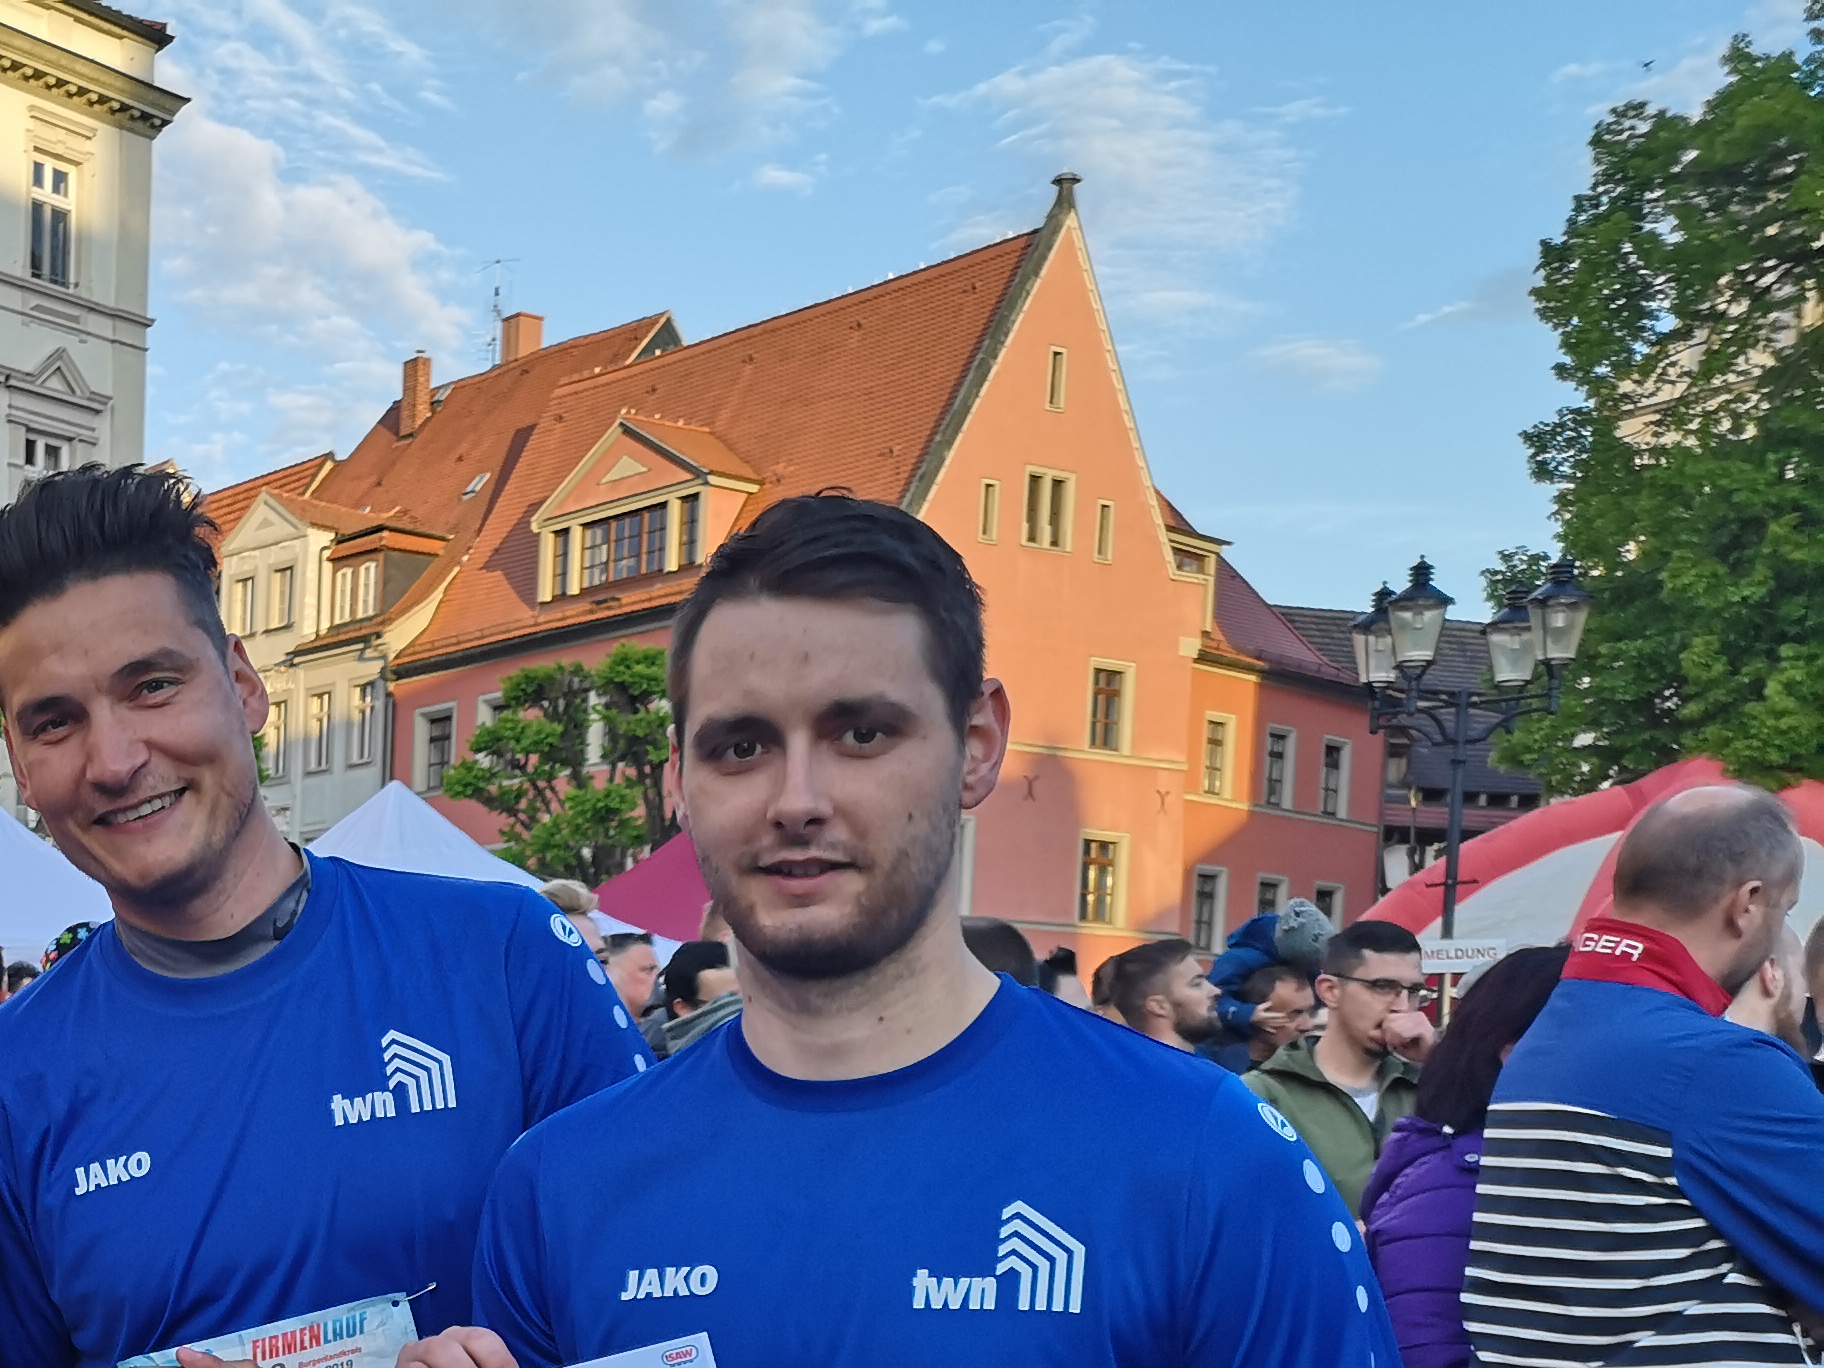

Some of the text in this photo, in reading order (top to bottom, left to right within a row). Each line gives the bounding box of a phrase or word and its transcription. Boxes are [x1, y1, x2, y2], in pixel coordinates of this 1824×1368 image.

[1579, 933, 1645, 962] GER
[74, 1151, 152, 1196] JAKO
[621, 1264, 719, 1301] JAKO
[252, 1310, 368, 1363] FIRMENLAUF
